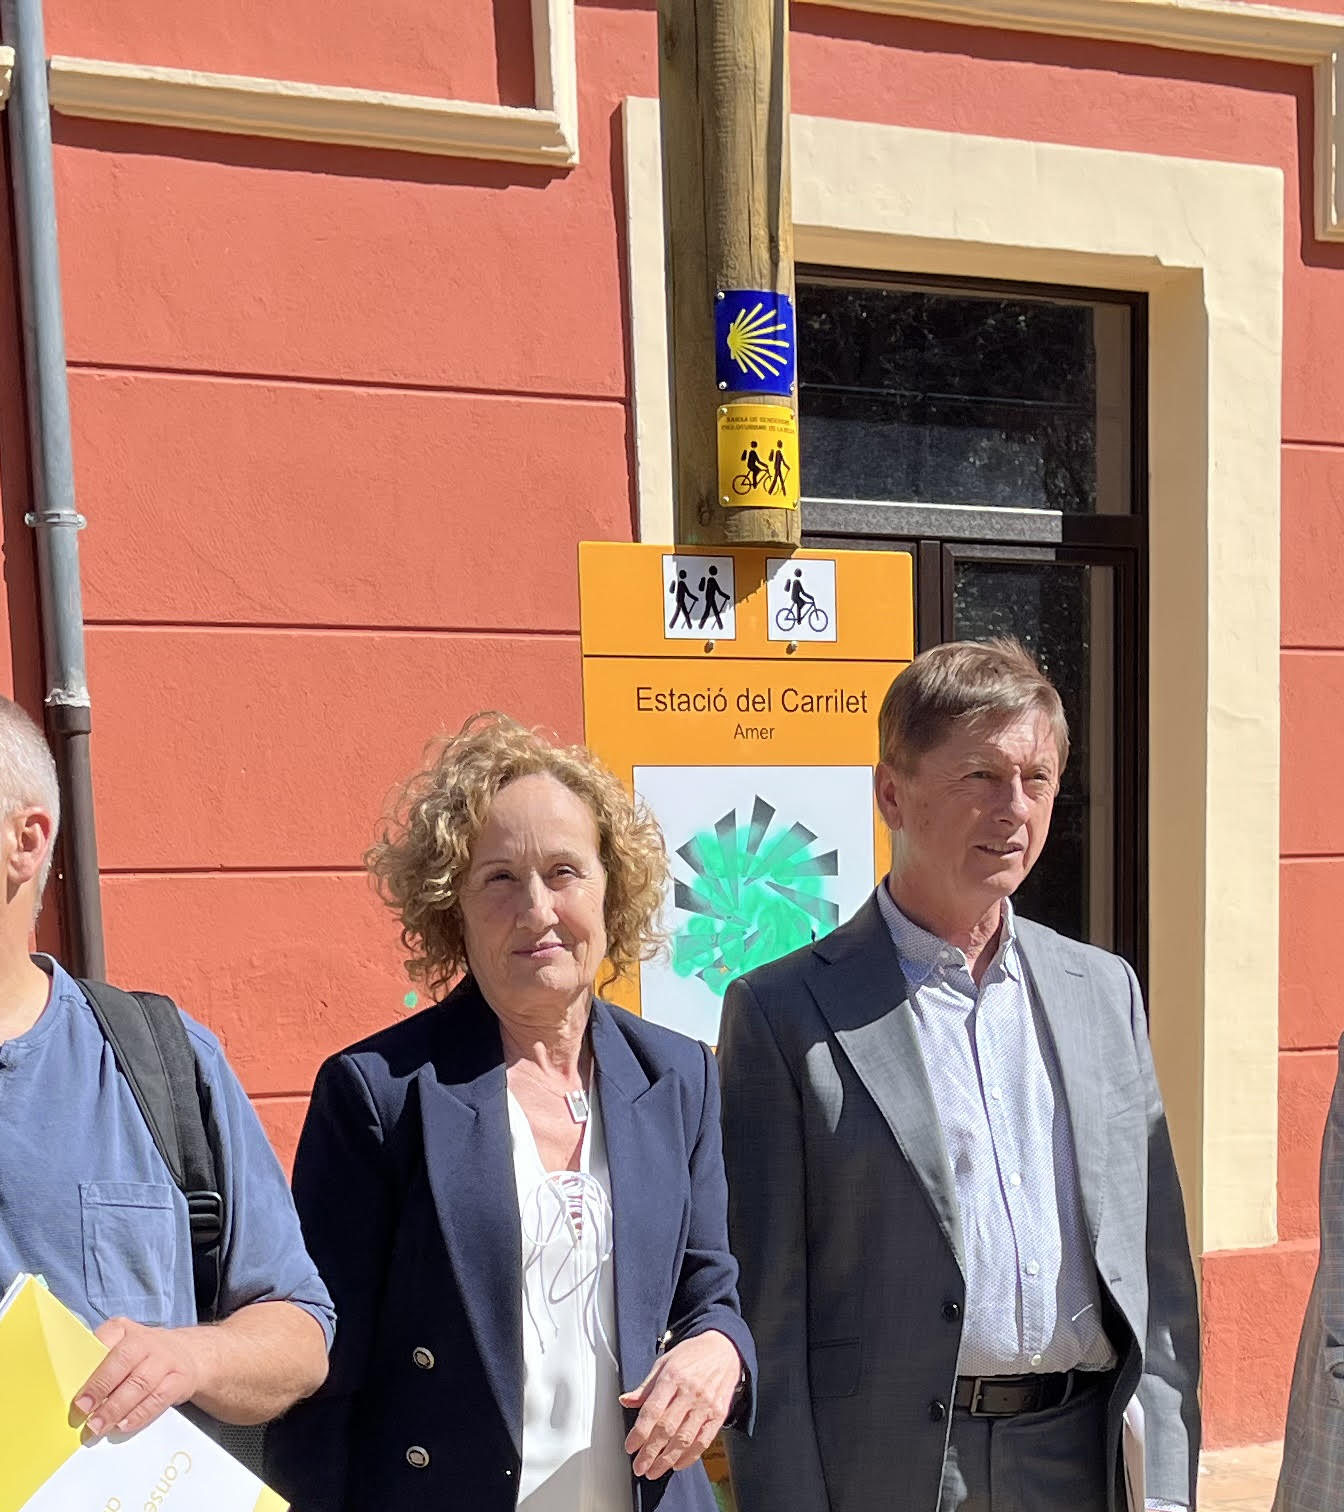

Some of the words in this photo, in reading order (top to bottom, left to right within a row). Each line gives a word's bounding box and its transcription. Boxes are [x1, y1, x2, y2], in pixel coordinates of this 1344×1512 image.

[636, 687, 728, 713] Estació
[736, 687, 772, 713] del
[781, 688, 868, 713] Carrilet
[733, 723, 775, 740] Amer
